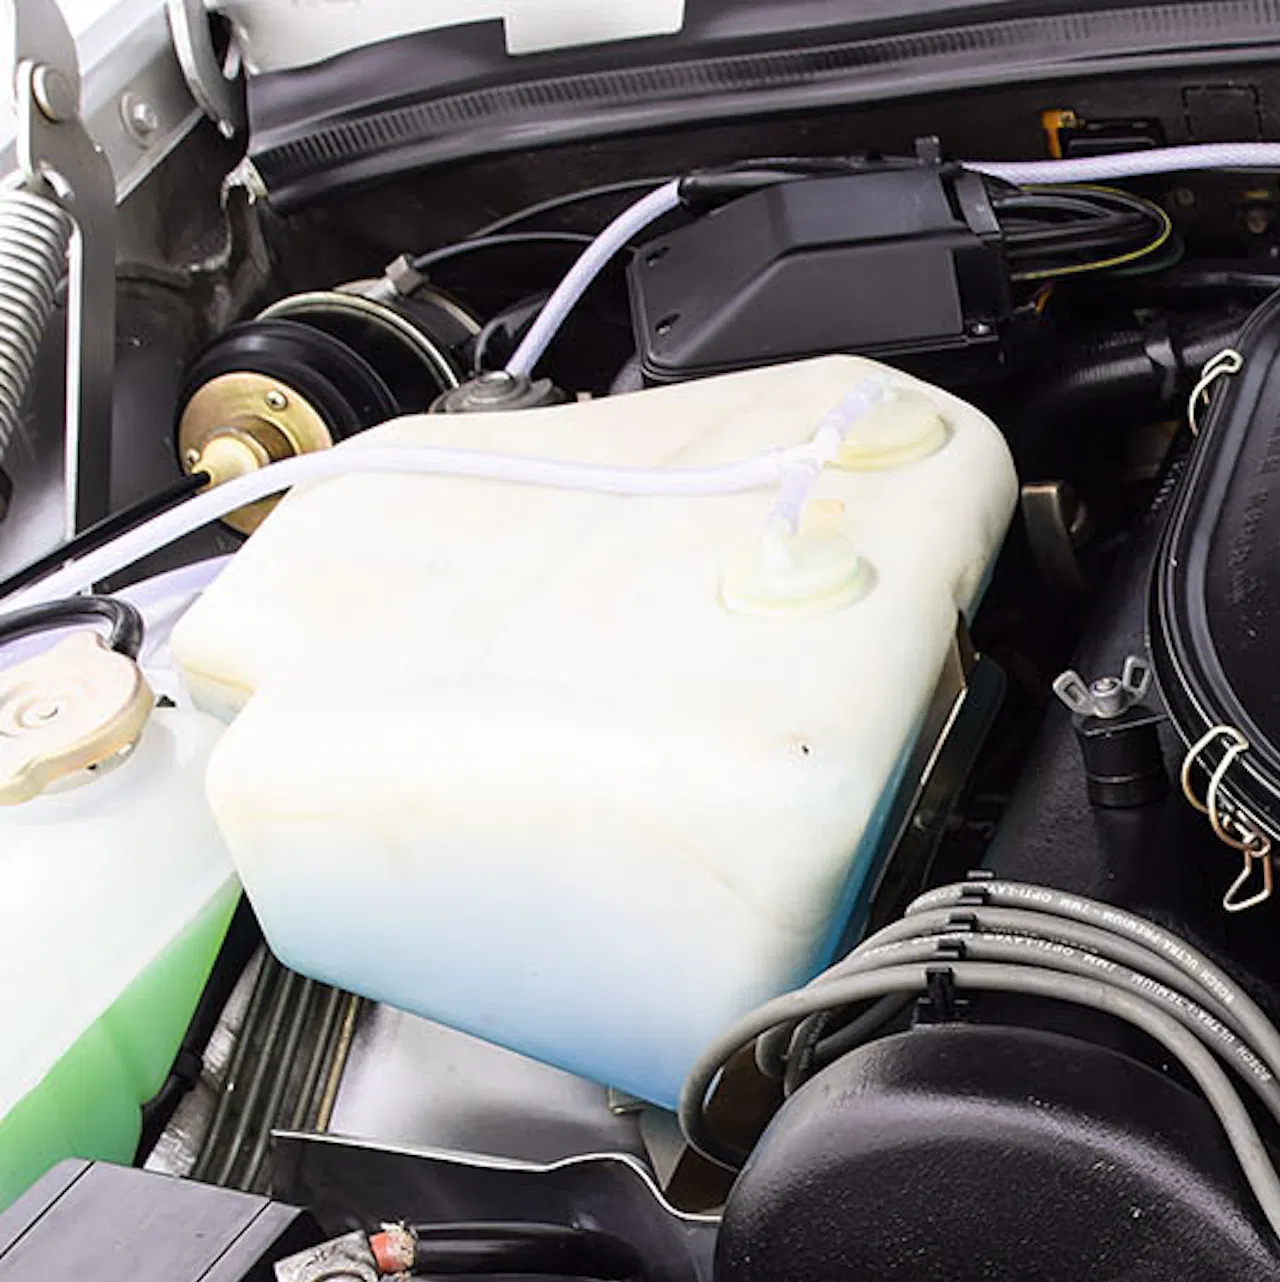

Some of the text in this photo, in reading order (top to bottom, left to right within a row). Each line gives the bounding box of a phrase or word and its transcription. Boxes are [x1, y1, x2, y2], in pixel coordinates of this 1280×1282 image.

[986, 883, 1053, 904] OPTI-LAY
[1199, 968, 1236, 1004] BOSCH
[1235, 1045, 1272, 1082] BOSCH
